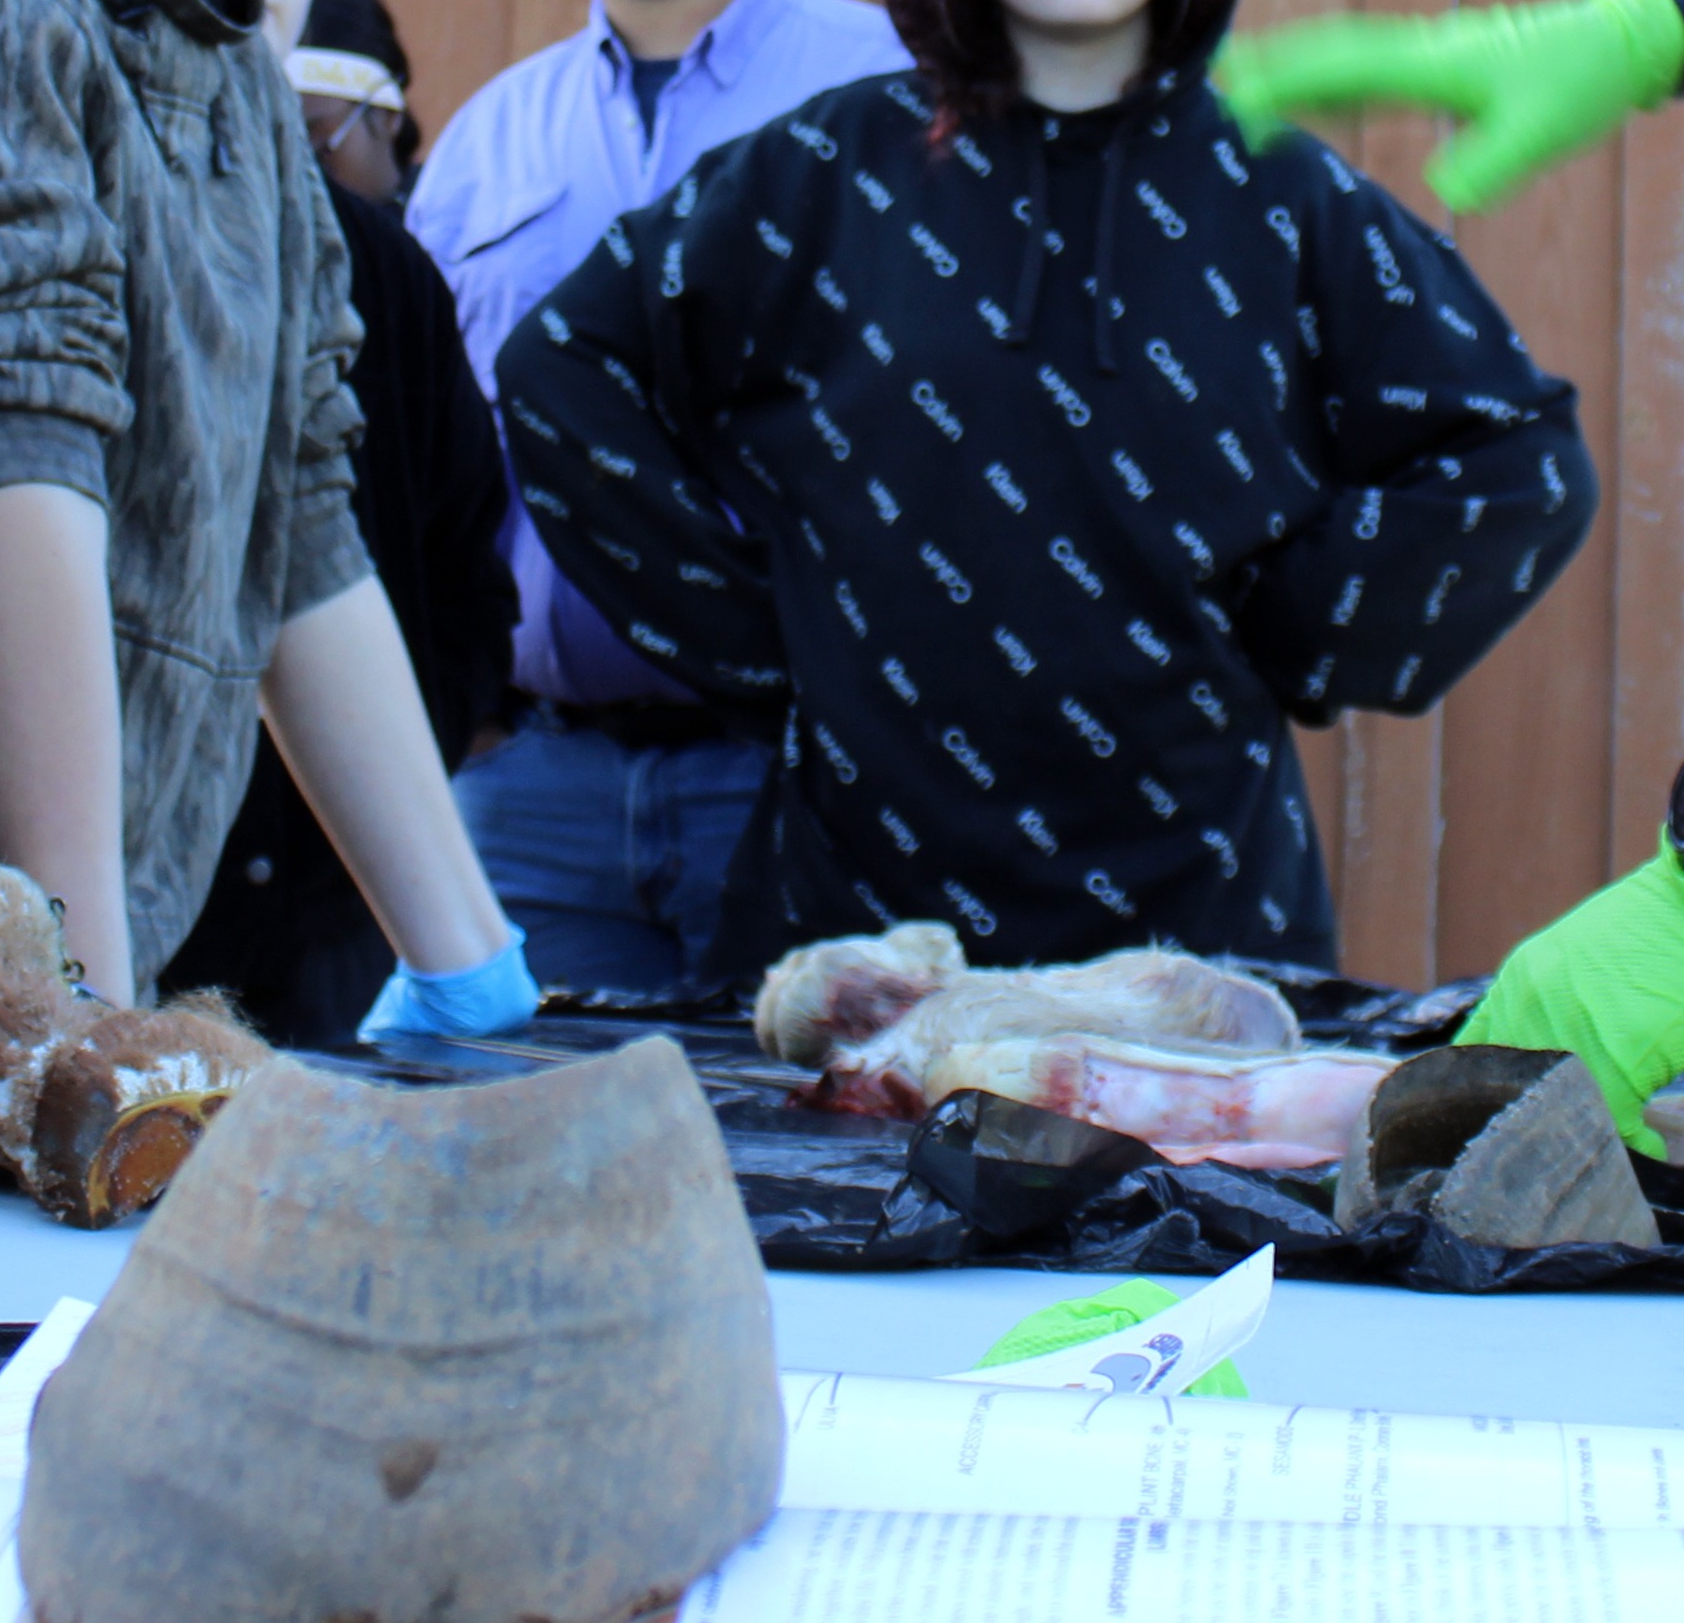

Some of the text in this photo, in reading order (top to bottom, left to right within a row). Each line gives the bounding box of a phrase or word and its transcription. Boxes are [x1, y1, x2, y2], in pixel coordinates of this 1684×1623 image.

[1211, 138, 1249, 186] Klein
[853, 170, 895, 213] Klein
[1135, 180, 1188, 239] Calvin
[908, 222, 960, 277] Calvin
[1364, 225, 1401, 288] Calvin
[1203, 265, 1241, 318] Klein
[1037, 364, 1092, 427] Calvin
[1145, 337, 1199, 402] Calvin
[911, 379, 964, 441] Calvin
[1110, 449, 1154, 502] Klein
[1215, 428, 1254, 482] Klein
[867, 477, 902, 525] Klein
[983, 460, 1028, 513] Klein
[919, 541, 973, 604] Calvin
[1048, 535, 1104, 598] Calvin
[993, 625, 1038, 676] Klein
[1125, 618, 1172, 666] Klein
[880, 656, 919, 704] Klein
[816, 723, 858, 783] Calvin
[1059, 696, 1117, 758] Calvin
[941, 726, 995, 788] Calvin
[1139, 776, 1179, 818] Klein
[879, 807, 920, 855] Klein
[1014, 805, 1058, 855] Klein
[943, 879, 998, 936] Calvin
[957, 1411, 988, 1477] ACCESSORY
[1344, 1443, 1367, 1491] PHALANX
[1137, 1475, 1160, 1518] PLINT
[1107, 1525, 1139, 1619] APPENDICULAR
